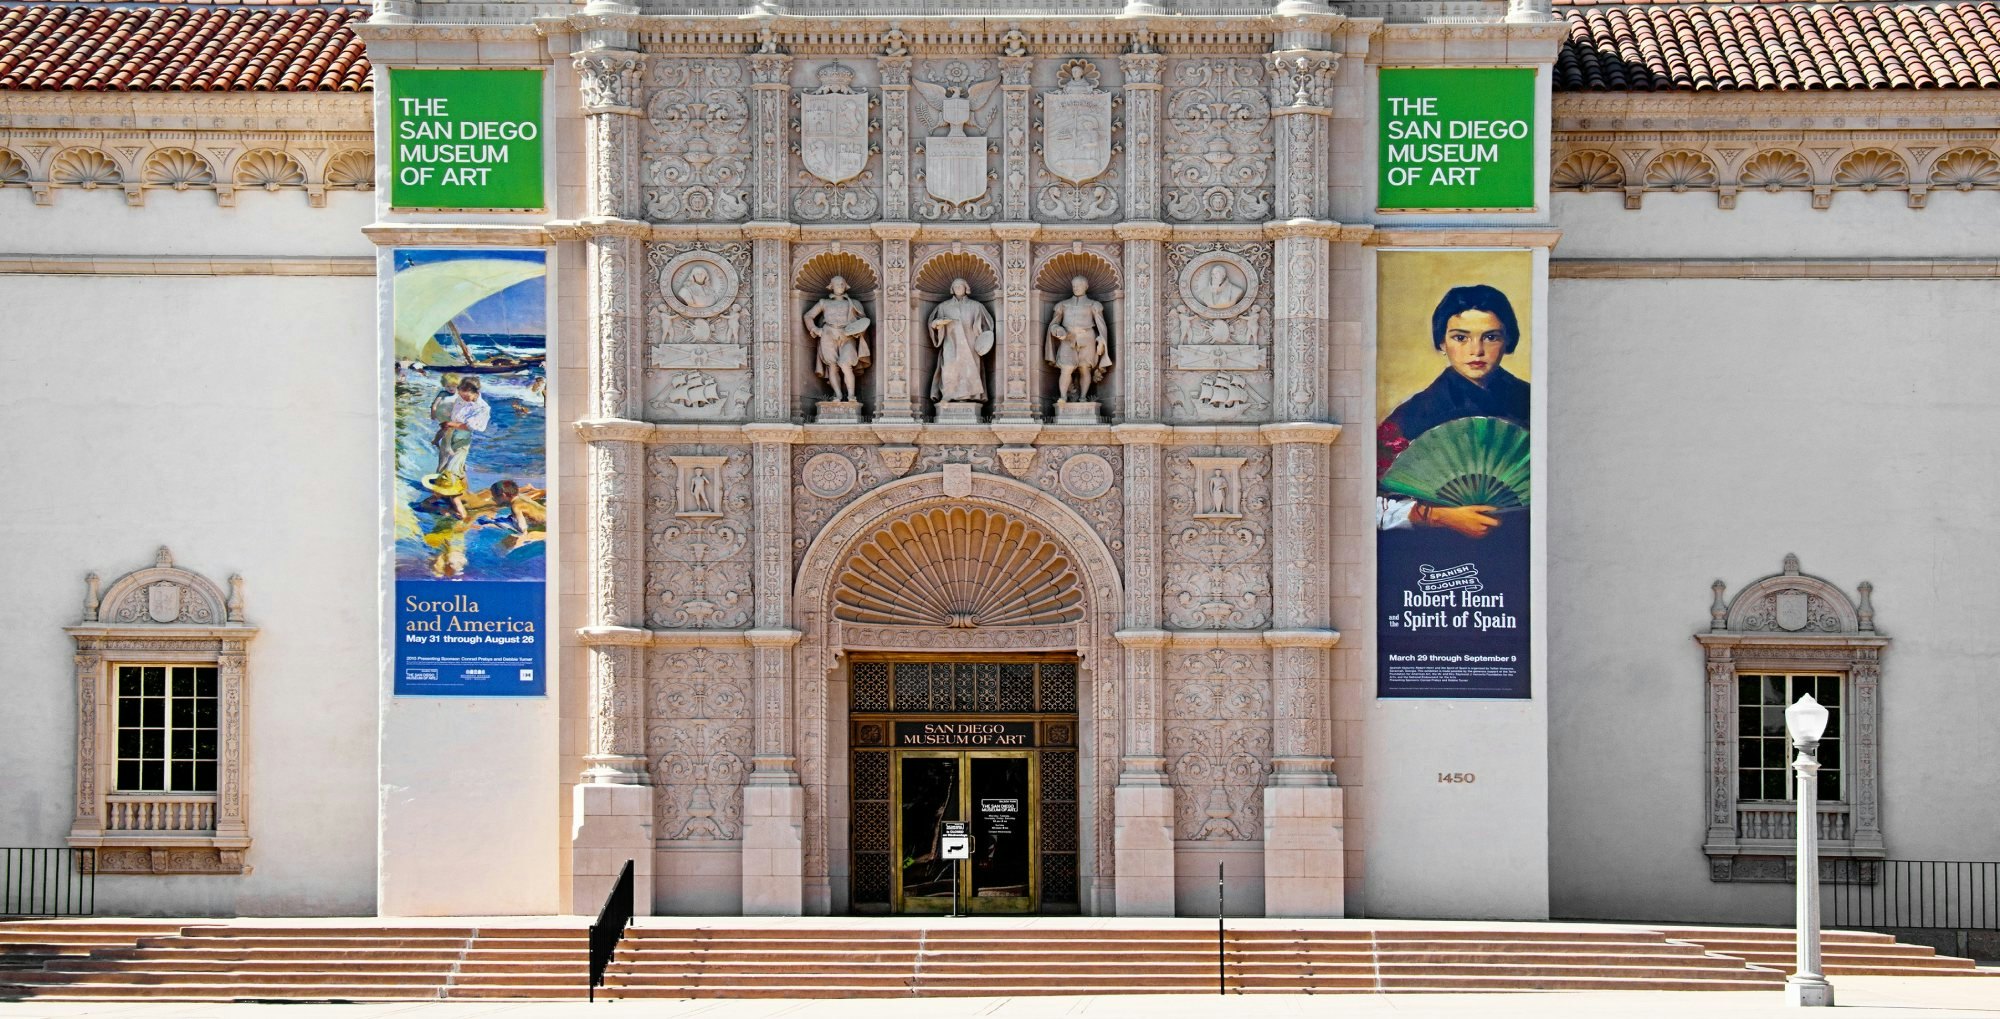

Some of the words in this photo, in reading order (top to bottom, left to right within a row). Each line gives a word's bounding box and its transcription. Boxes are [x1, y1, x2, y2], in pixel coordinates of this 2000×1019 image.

[399, 98, 448, 117] THE
[1388, 97, 1438, 116] THE
[400, 121, 452, 140] SAN
[460, 121, 538, 141] DIEGO
[1388, 120, 1441, 140] SAN
[1450, 120, 1529, 140] DIEGO
[400, 144, 509, 163] MUSEUM
[1388, 144, 1498, 163] MUSEUM
[400, 167, 435, 186] OF
[441, 167, 492, 186] ART
[1387, 167, 1423, 186] OF
[1429, 167, 1481, 186] ART
[1430, 566, 1469, 580] SPANISH
[1425, 579, 1475, 591] SOJOURNS
[406, 594, 479, 613] Sorolla
[1403, 590, 1457, 608] Robert
[1461, 590, 1504, 608] Henri
[406, 615, 442, 632] and
[446, 615, 535, 633] America
[1388, 613, 1400, 621] and
[1403, 611, 1448, 631] Spirit
[1452, 611, 1469, 628] of
[1474, 611, 1517, 632] Spain
[406, 634, 427, 645] May
[429, 634, 440, 643] 31
[443, 634, 483, 645] through
[484, 635, 520, 645] August
[521, 635, 535, 644] 26
[1389, 654, 1416, 662] March
[1417, 654, 1428, 662] 29
[1429, 654, 1462, 663] through
[1463, 655, 1510, 663] September
[924, 724, 955, 734] SAN
[958, 724, 1005, 734] DIEGO
[904, 734, 969, 745] MUSEUM
[972, 734, 992, 744] OF
[995, 734, 1026, 745] ART
[1437, 772, 1476, 784] 1450
